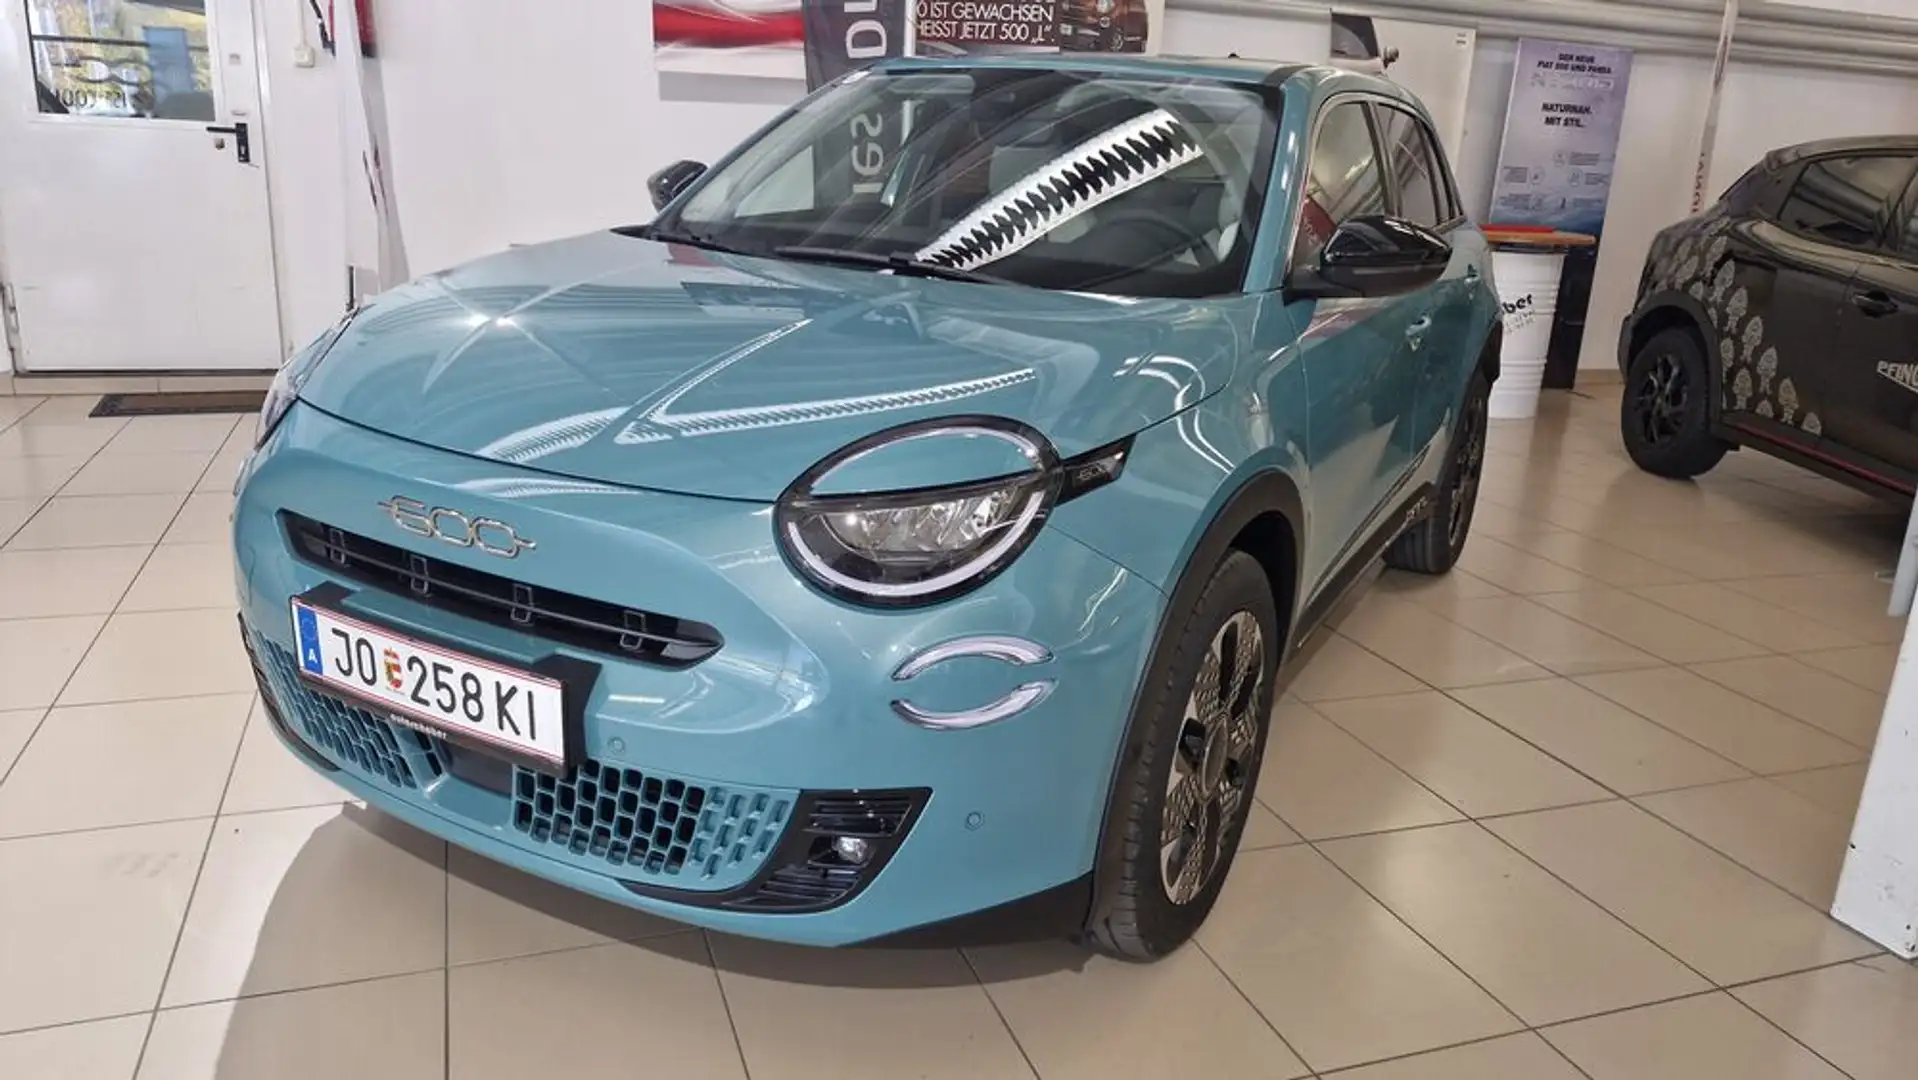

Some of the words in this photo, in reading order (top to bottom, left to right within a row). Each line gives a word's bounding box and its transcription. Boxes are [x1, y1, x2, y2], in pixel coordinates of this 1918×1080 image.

[930, 2, 949, 18] IST
[951, 2, 1053, 22] GEWACHSEN
[960, 21, 997, 39] JETZT
[999, 23, 1029, 40] 500
[1545, 117, 1561, 126] MIT
[381, 495, 534, 559] 600
[308, 651, 318, 663] A
[331, 627, 377, 686] JO
[407, 655, 484, 723] 258
[495, 680, 536, 740] KI
